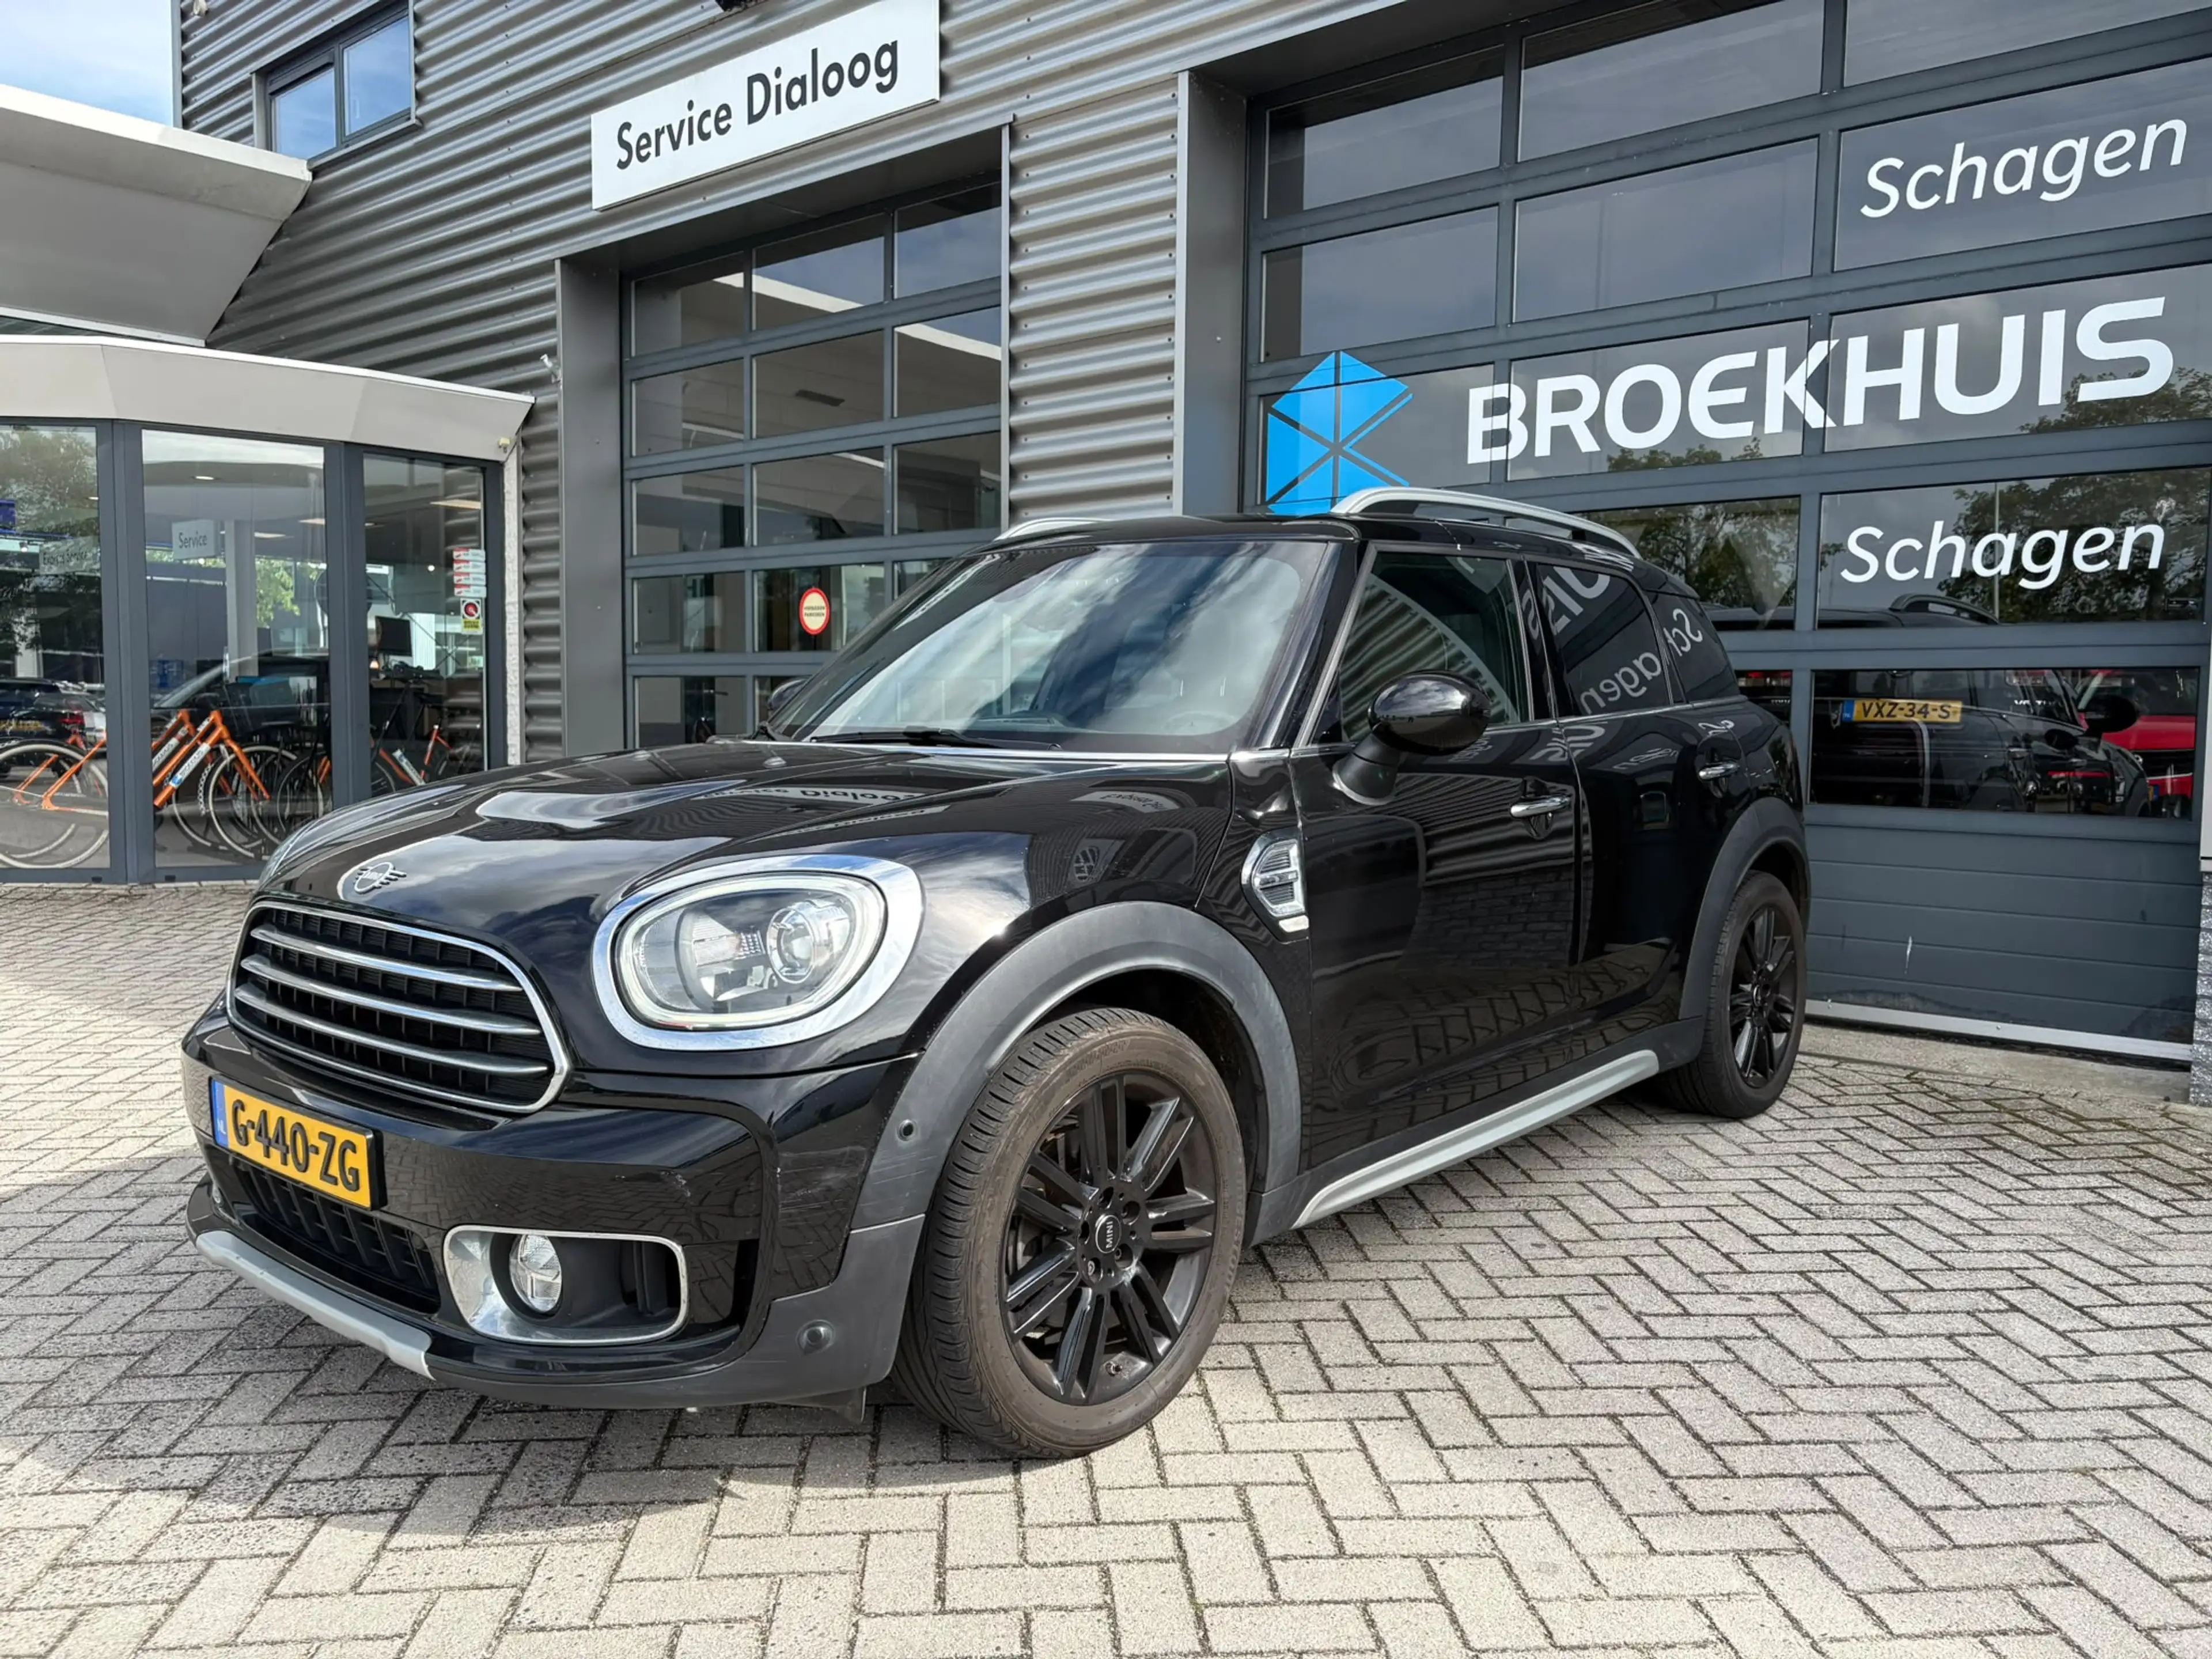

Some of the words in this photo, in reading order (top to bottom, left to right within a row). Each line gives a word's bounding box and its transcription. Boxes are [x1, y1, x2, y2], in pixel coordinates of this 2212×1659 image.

[616, 100, 732, 169] Service
[747, 40, 898, 125] Dialoog
[1861, 118, 2187, 218] Schagen
[1467, 297, 2174, 465] BROEKHUIS
[178, 529, 208, 549] Service
[1840, 520, 2164, 590] Schagen
[1862, 701, 1952, 719] VXZ-34-S
[217, 1118, 226, 1134] NL
[232, 1099, 360, 1192] G-440-ZG
[1105, 1221, 1113, 1249] MINI
